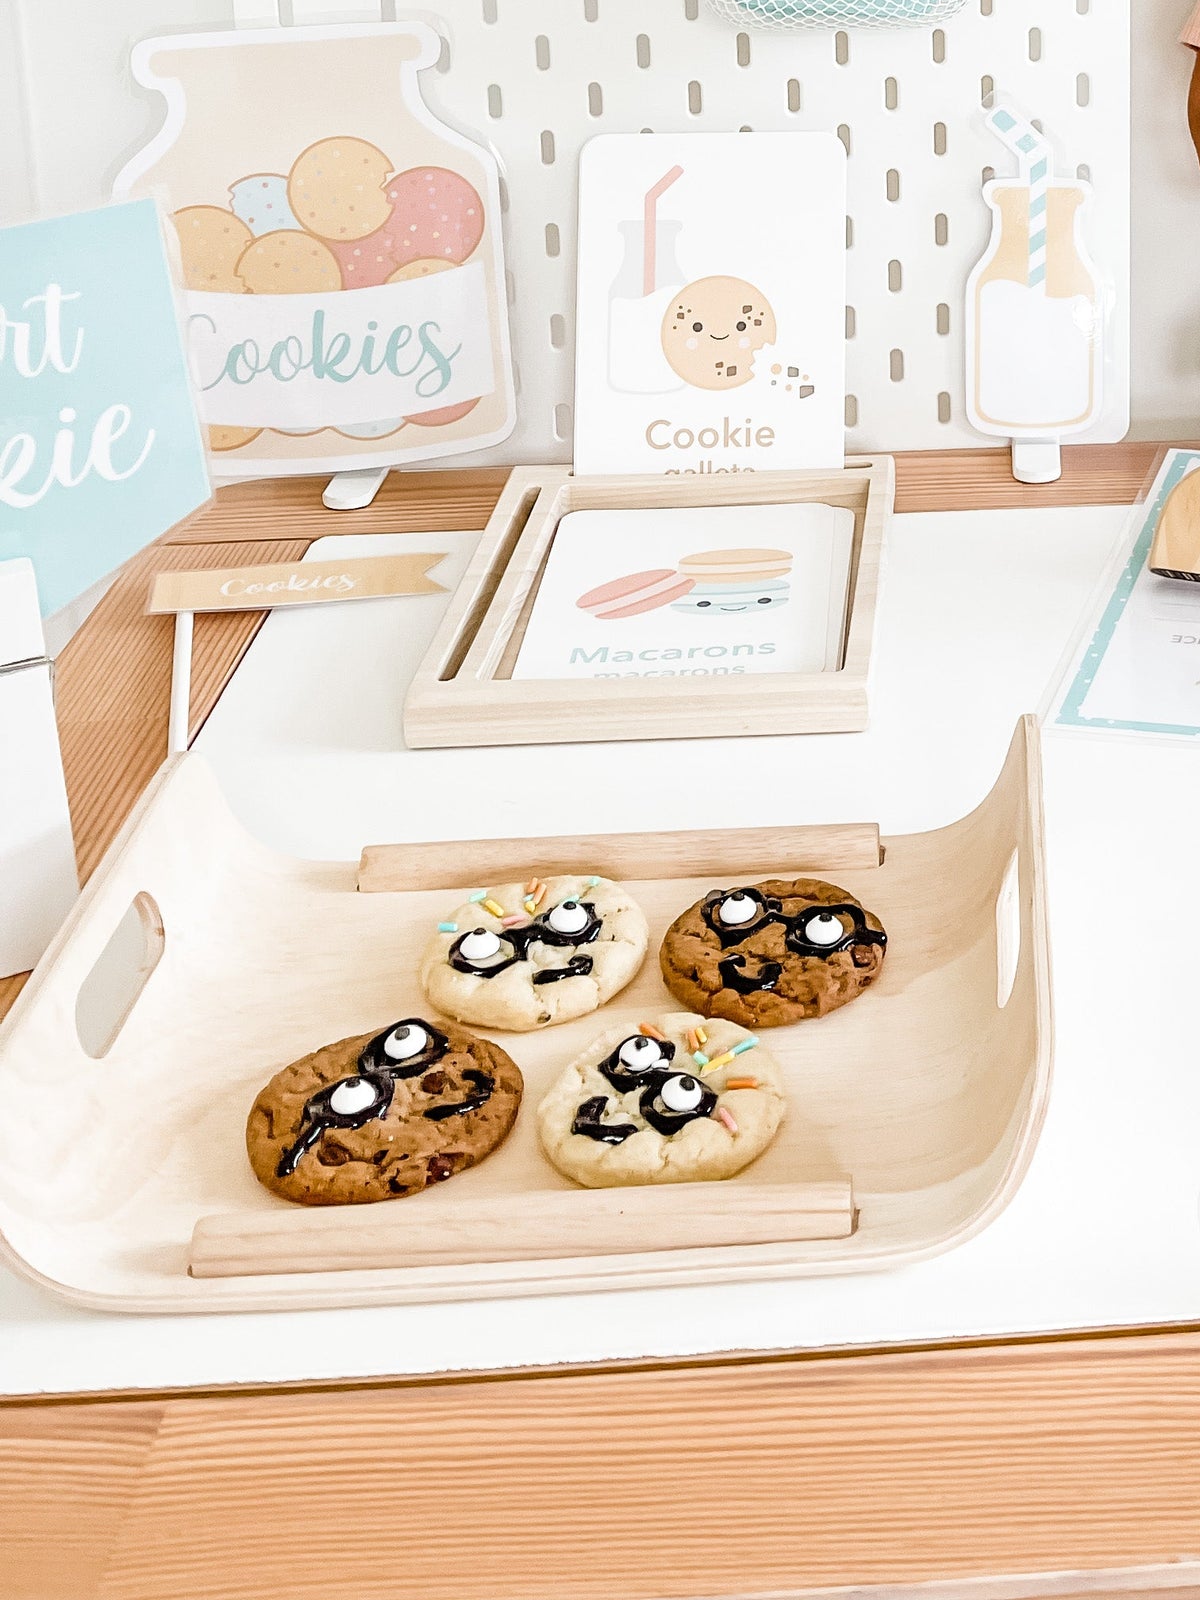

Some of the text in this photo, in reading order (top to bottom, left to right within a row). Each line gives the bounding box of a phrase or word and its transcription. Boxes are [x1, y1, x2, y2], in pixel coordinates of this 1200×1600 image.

[645, 416, 776, 450] Cookie
[219, 574, 361, 597] Cookies
[569, 642, 777, 664] Macarons
